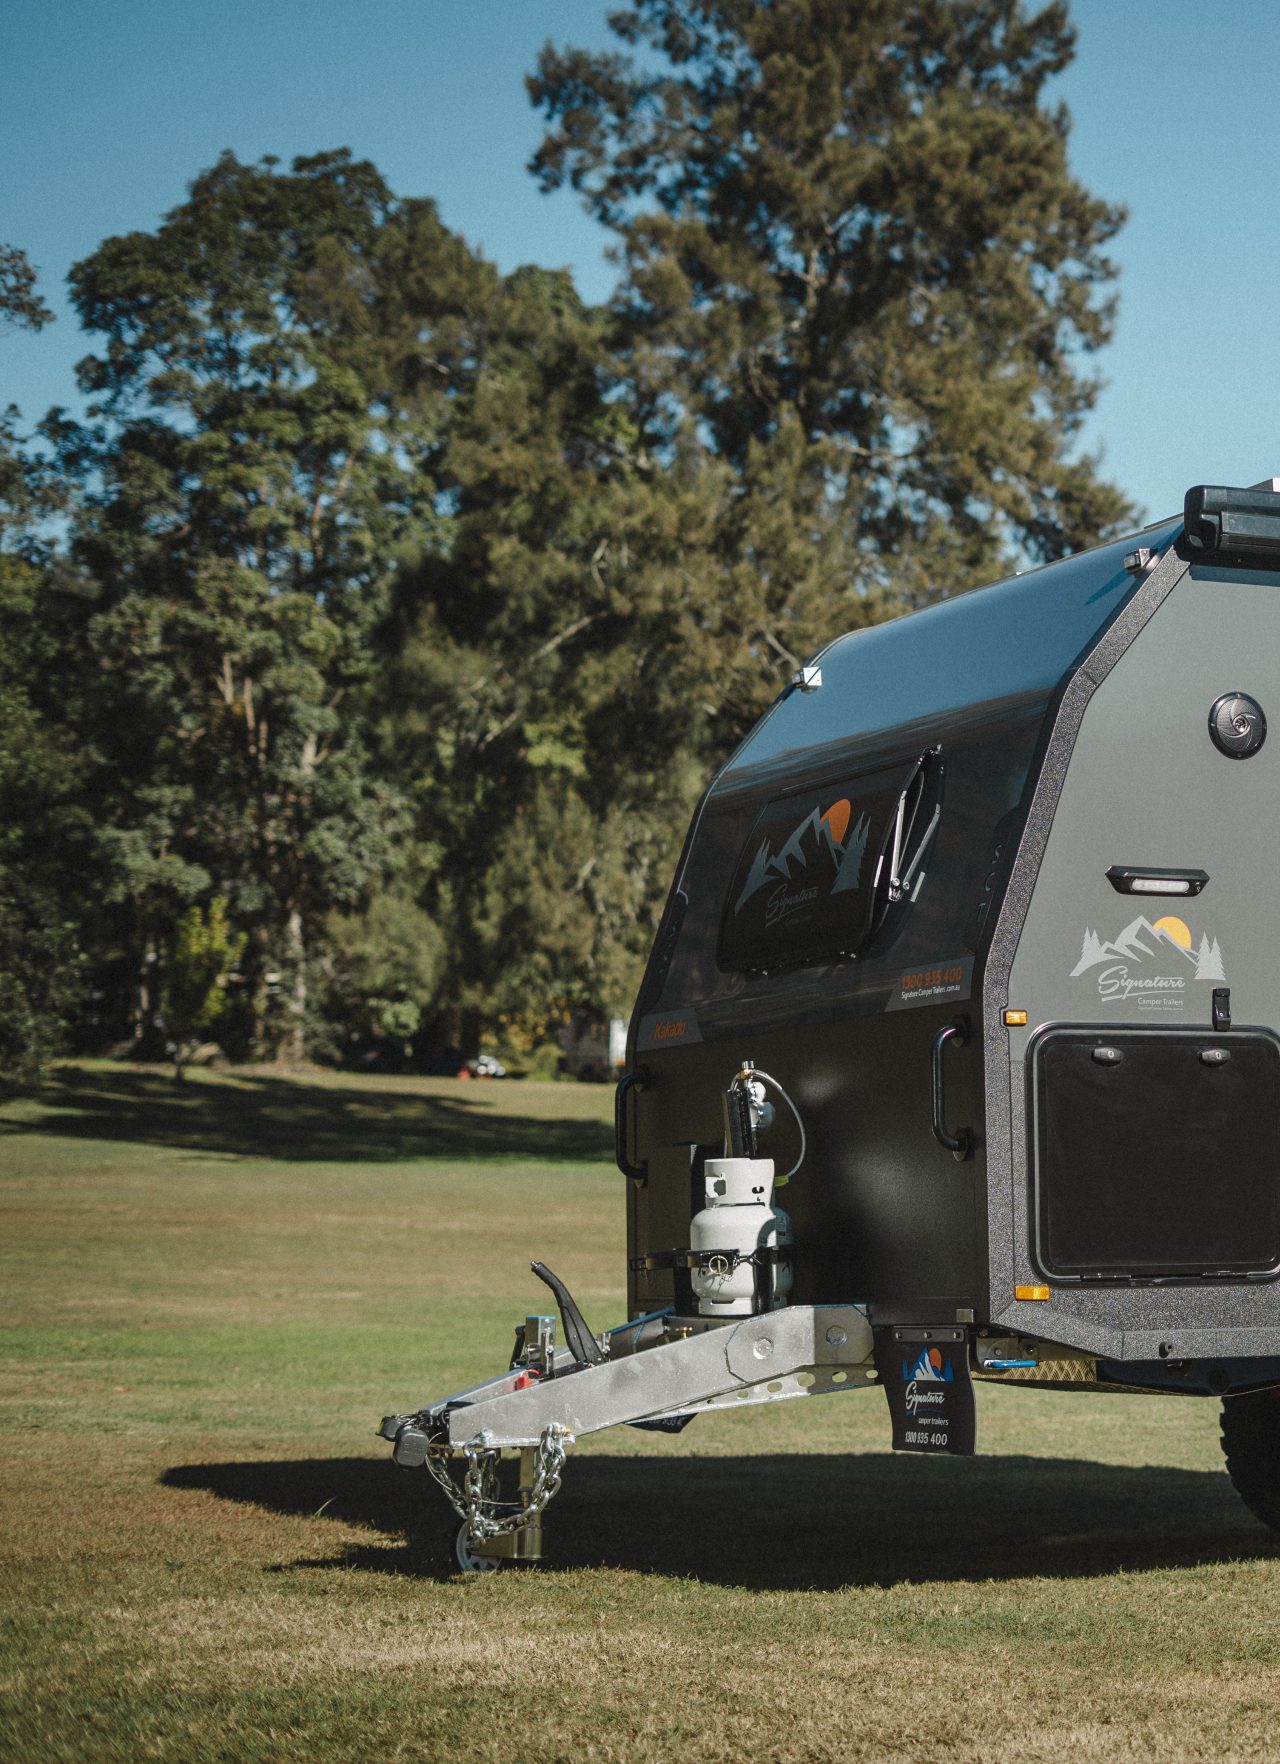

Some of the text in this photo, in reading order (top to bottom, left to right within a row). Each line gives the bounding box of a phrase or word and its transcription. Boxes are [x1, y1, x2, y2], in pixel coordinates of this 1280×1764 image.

[902, 974, 922, 991] 1300
[1098, 965, 1186, 1000] Signature
[1137, 997, 1184, 1007] Camper Trailers
[652, 1019, 687, 1040] Kakadu
[905, 1381, 945, 1416] Signature
[931, 1417, 949, 1426] trailers
[905, 1430, 948, 1446] 1300 935 400
